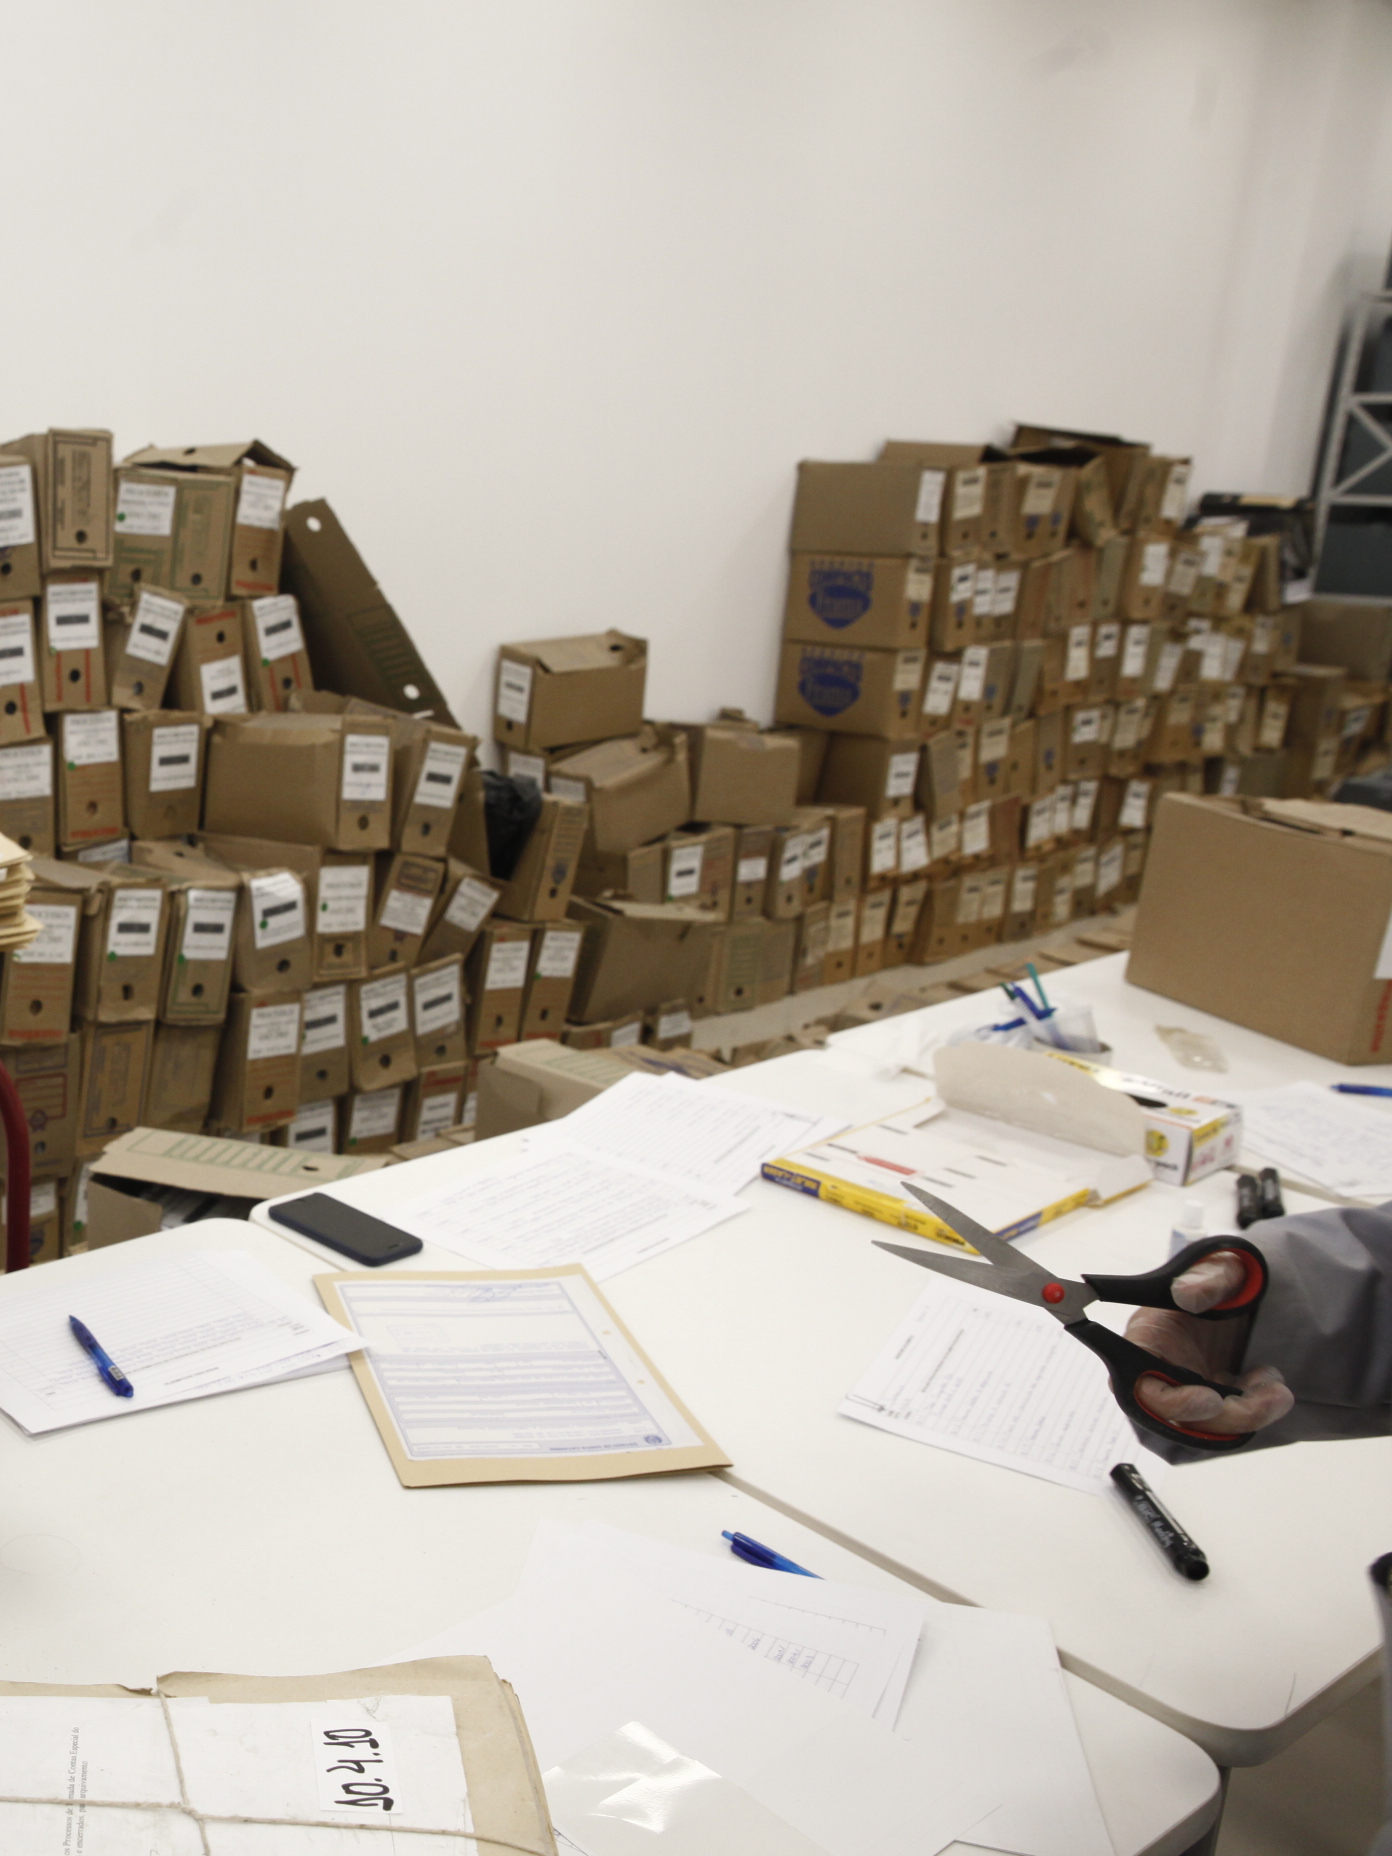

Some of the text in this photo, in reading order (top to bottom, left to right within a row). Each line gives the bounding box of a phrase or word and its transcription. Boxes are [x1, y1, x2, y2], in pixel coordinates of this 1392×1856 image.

[71, 1726, 80, 1734] do
[69, 1734, 79, 1755] Especial
[68, 1755, 77, 1774] Contas
[65, 1807, 74, 1815] de
[63, 1816, 73, 1847] Processos
